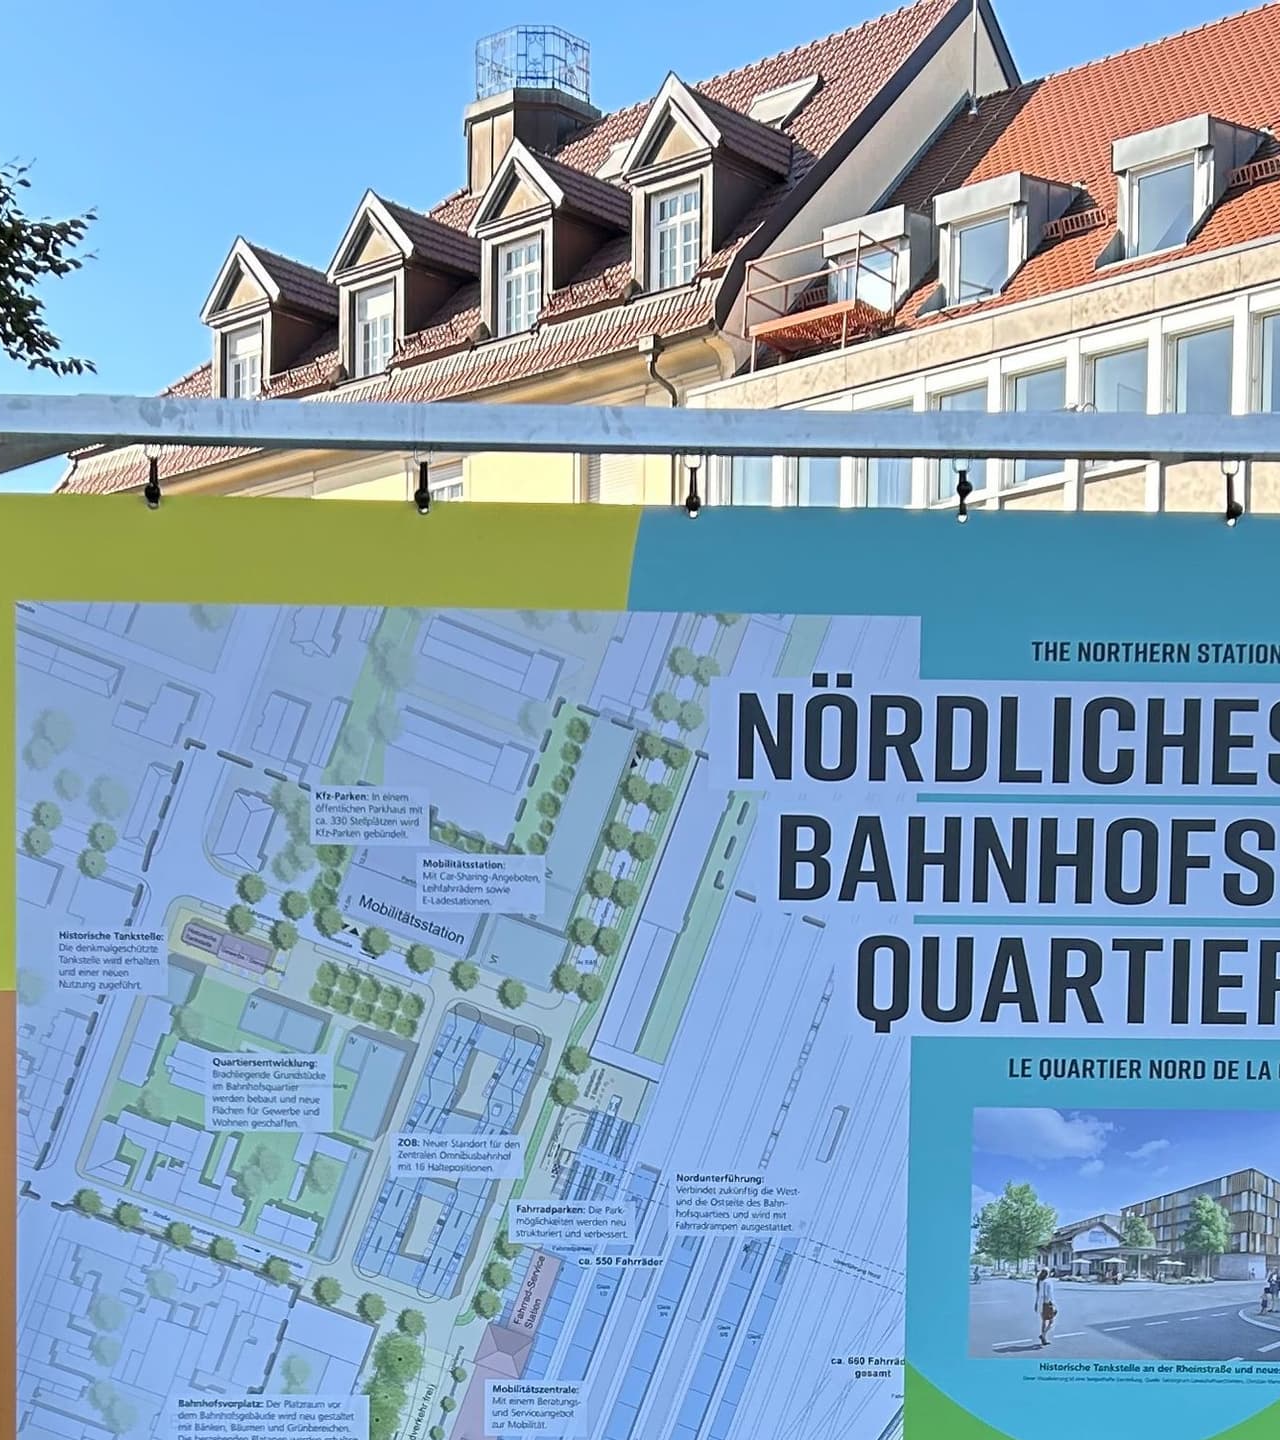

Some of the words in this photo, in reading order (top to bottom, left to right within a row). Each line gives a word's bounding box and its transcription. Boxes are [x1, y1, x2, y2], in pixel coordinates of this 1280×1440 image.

[1032, 641, 1071, 662] THE
[1078, 642, 1190, 663] NORTHERN
[359, 895, 464, 944] Mobilitätsstation
[212, 1058, 318, 1069] Quartiersentwicklung:
[1009, 1059, 1032, 1078] LE
[1039, 1059, 1142, 1080] QUARTIER
[1150, 1060, 1205, 1080] NORD
[1214, 1061, 1239, 1080] DE
[1247, 1061, 1271, 1080] LA
[596, 1257, 612, 1265] 550
[616, 1257, 663, 1266] Fahrräder
[1040, 1363, 1090, 1371] Historische
[1094, 1364, 1139, 1372] Tankstelle
[1158, 1364, 1174, 1372] der
[1176, 1365, 1231, 1373] Rheinstraße
